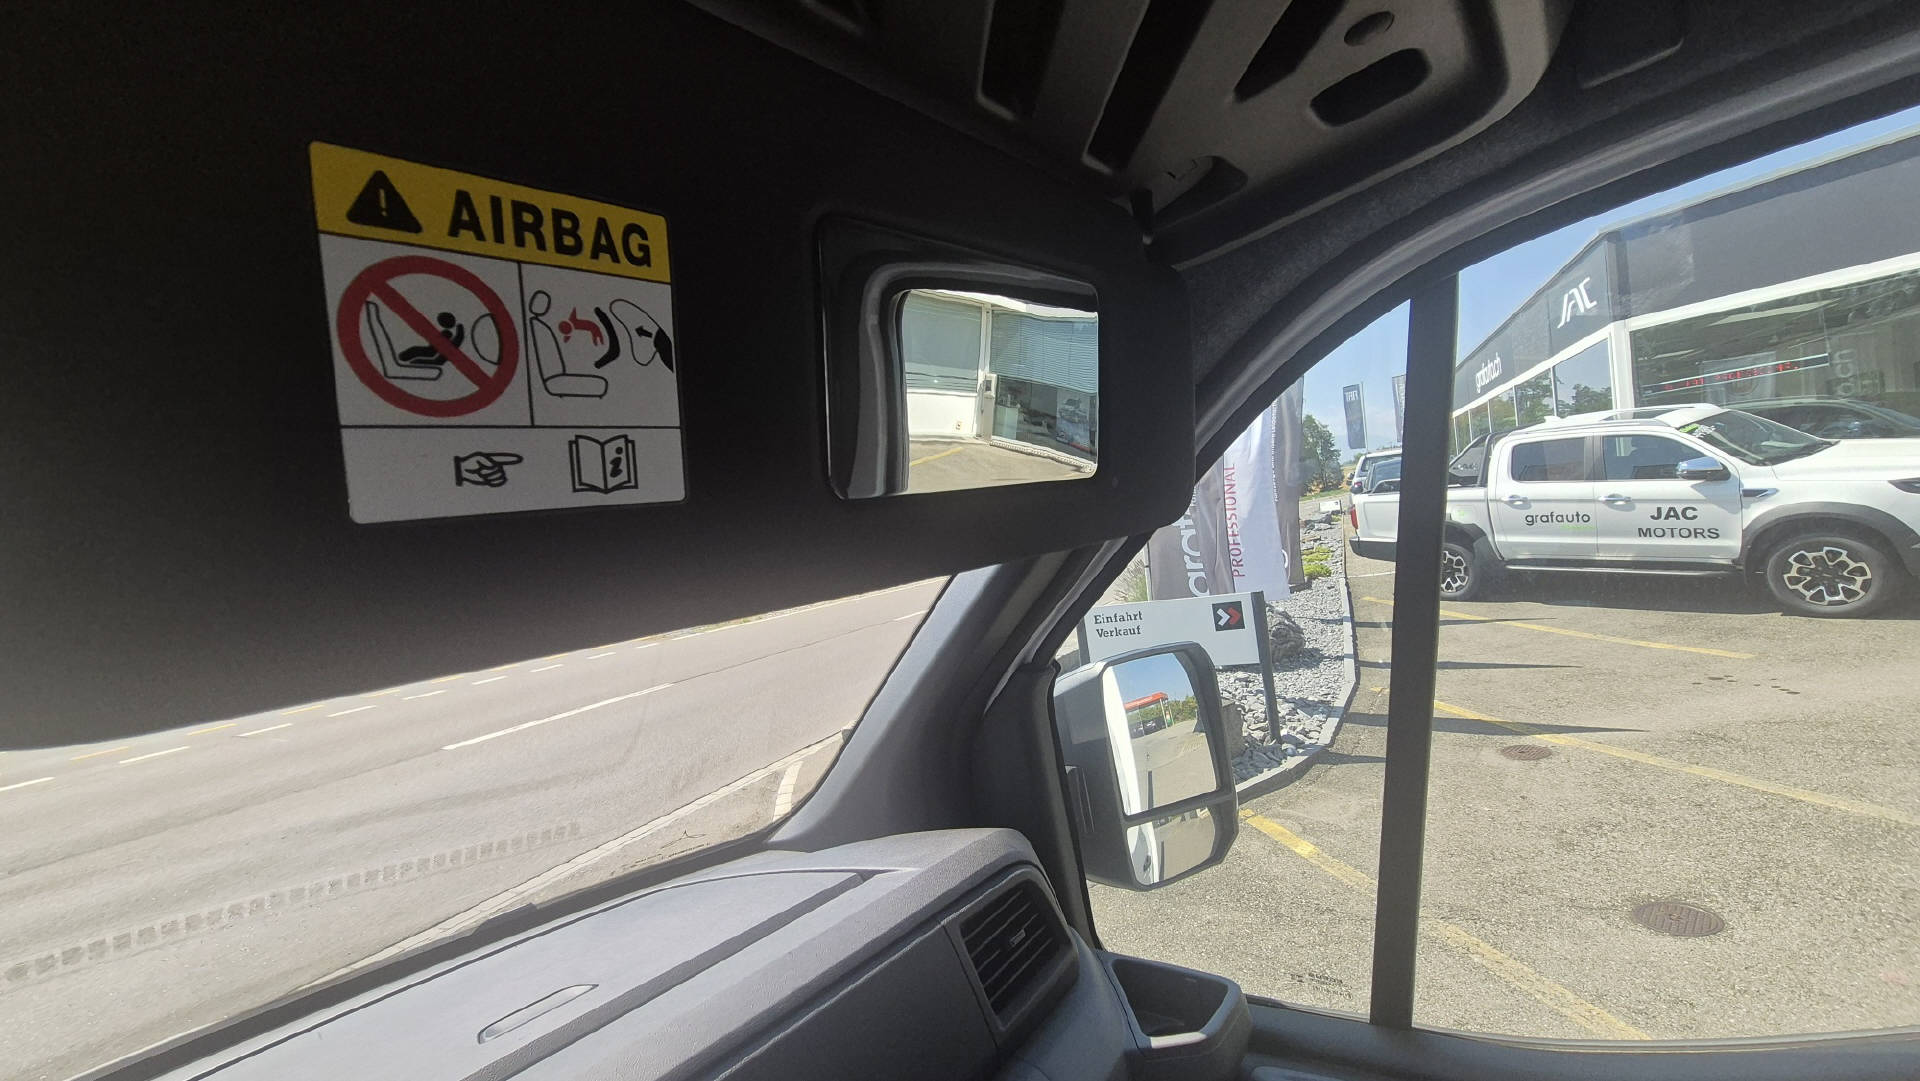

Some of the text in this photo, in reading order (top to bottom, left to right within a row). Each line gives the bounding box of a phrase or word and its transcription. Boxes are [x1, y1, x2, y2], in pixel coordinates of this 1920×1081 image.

[447, 188, 651, 268] AIRBAG
[1557, 276, 1597, 328] JAC
[1223, 463, 1245, 578] PROFESSIONAL
[1525, 511, 1591, 526] grafauto
[1650, 506, 1698, 521] JAC
[1638, 527, 1720, 539] MOTORS
[1093, 611, 1143, 624] Einfahrt
[1095, 625, 1142, 638] Verkauf
